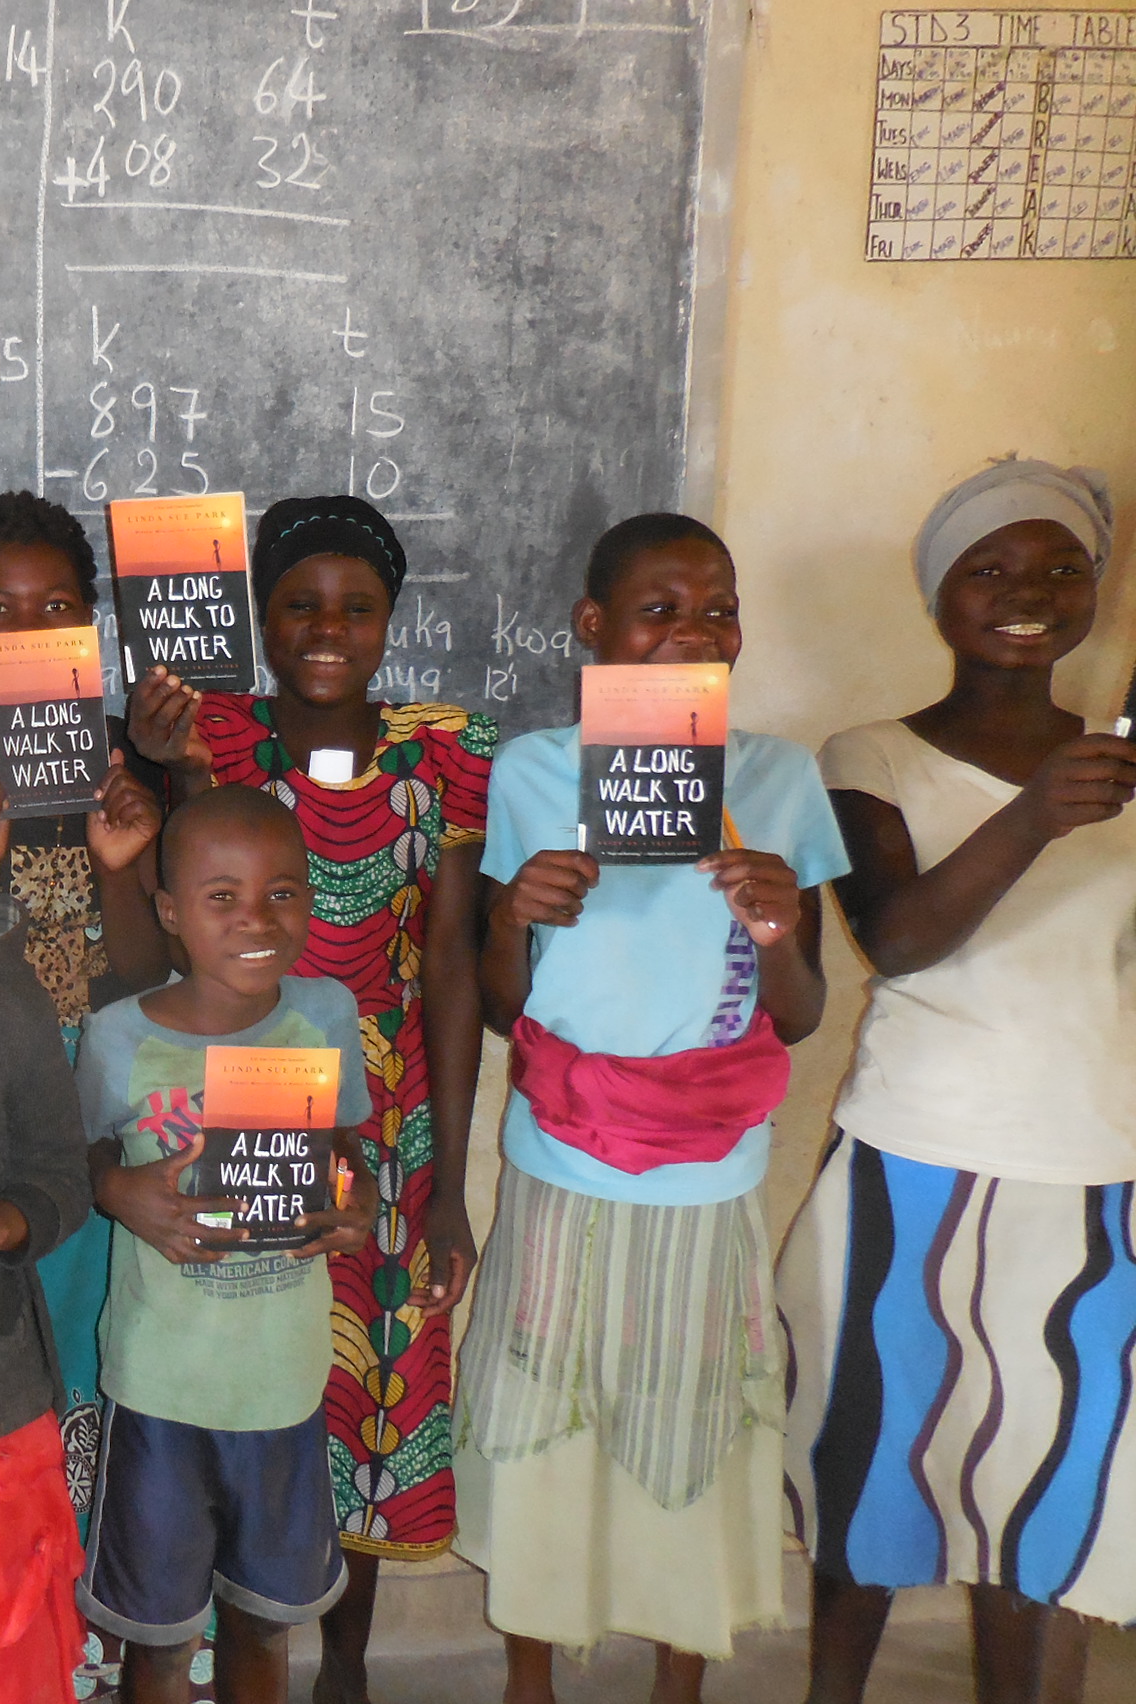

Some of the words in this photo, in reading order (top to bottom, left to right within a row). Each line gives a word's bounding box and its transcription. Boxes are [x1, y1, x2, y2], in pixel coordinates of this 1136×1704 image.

[891, 14, 948, 46] STD
[993, 13, 1042, 47] TIME
[5, 25, 48, 87] 14
[93, 58, 182, 128] 290
[252, 55, 327, 119] 64
[881, 88, 910, 109] MON
[870, 234, 893, 258] FRI
[90, 382, 208, 442] 897
[350, 387, 406, 438] 15
[348, 456, 401, 499] 10
[127, 515, 163, 523] LINDA
[195, 511, 227, 520] PARK
[147, 578, 163, 602] A
[168, 575, 223, 601] LONG
[139, 605, 202, 630] WALK
[205, 604, 236, 629] TO
[56, 639, 85, 648] PARK
[148, 634, 233, 662] WATER
[10, 706, 26, 730] A
[31, 702, 82, 729] LONG
[2, 731, 63, 758] WALK
[65, 728, 94, 753] TO
[11, 758, 92, 788] WATER
[608, 748, 627, 773] A
[632, 748, 696, 774] LONG
[598, 778, 668, 803] WALK
[672, 778, 705, 804] TO
[605, 809, 696, 838] WATER
[223, 1065, 262, 1074] LINDA
[231, 1132, 247, 1158] A
[253, 1132, 309, 1159] LONG
[219, 1161, 283, 1188] WALK
[289, 1161, 315, 1187] TO
